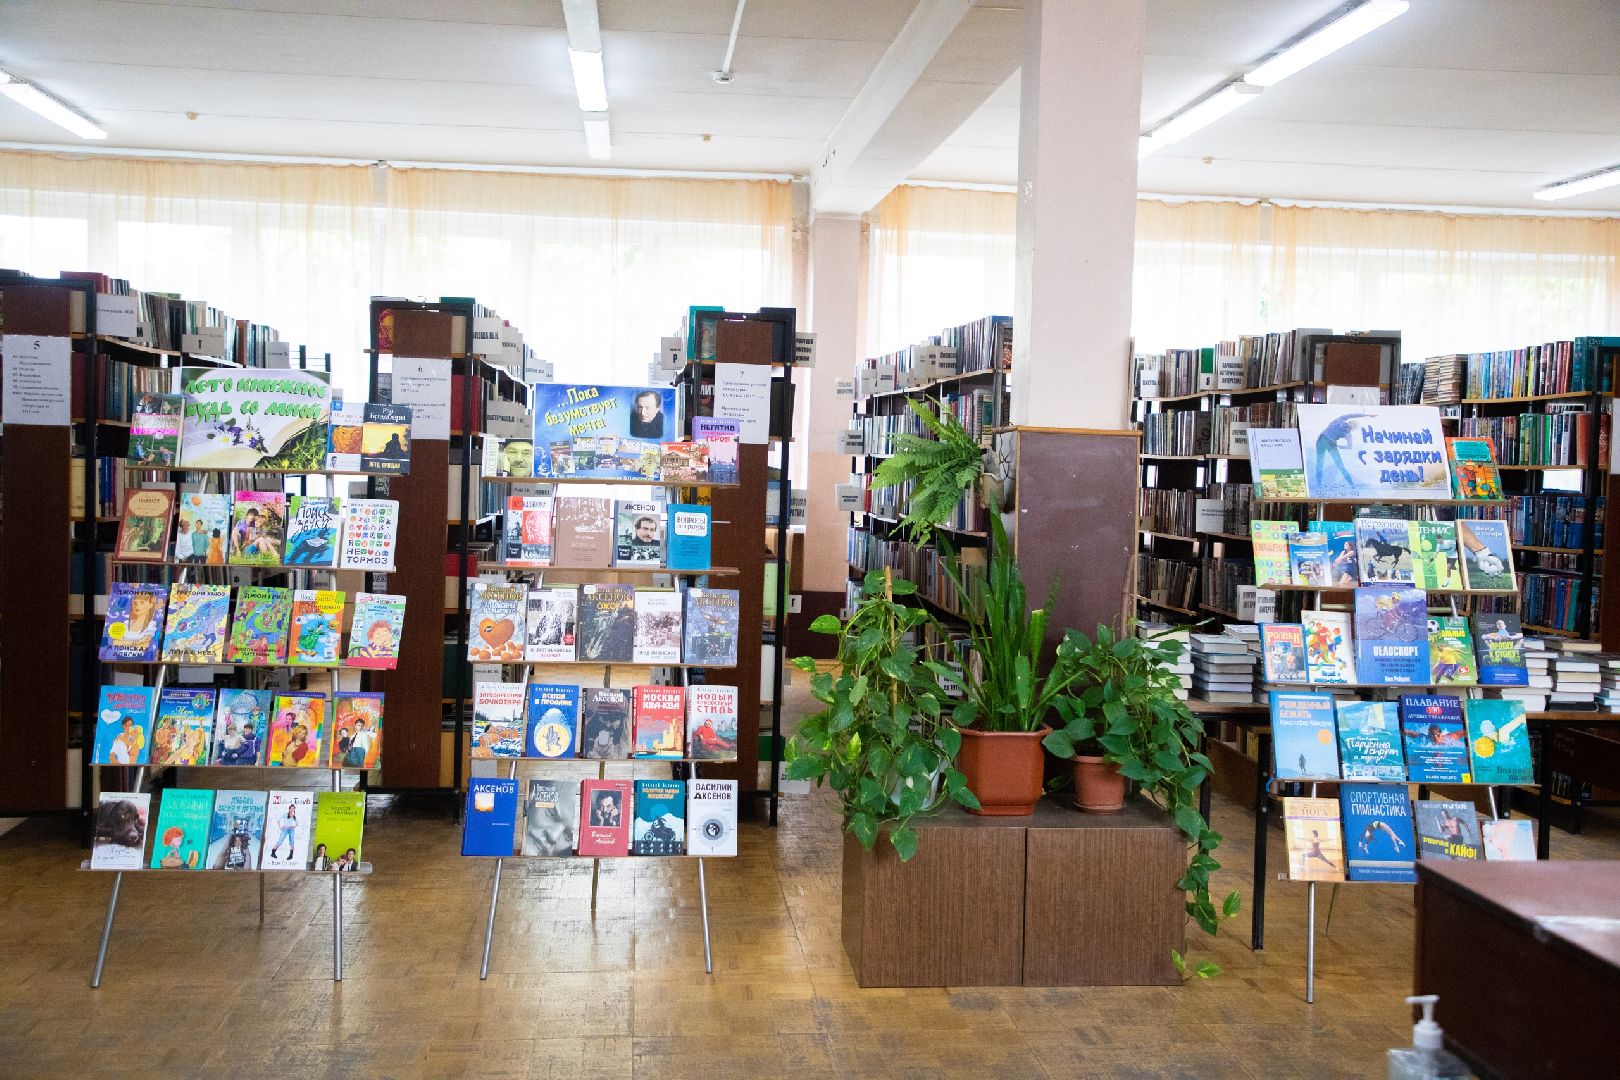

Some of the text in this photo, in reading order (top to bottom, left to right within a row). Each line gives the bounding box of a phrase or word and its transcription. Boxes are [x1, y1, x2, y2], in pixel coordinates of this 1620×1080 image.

[33, 341, 41, 350] 5
[185, 401, 233, 422] БУДЬ
[240, 400, 259, 415] СО
[544, 398, 618, 426] безумствует
[568, 417, 607, 436] мечта
[1361, 424, 1433, 445] Начинай
[1373, 450, 1442, 469] зарядки
[1380, 466, 1425, 483] день!
[624, 503, 656, 511] АКСЕНОВ
[1418, 526, 1452, 534] ТЕННИС
[346, 556, 388, 565] ТОРМОЗ
[1373, 646, 1418, 657] ВЕЛОСПОРТ
[643, 693, 681, 702] МОСКВА
[1405, 697, 1459, 708] ПЛАВАНИЕ
[643, 702, 680, 710] КВА-КВА
[473, 785, 514, 793] АКСЕНОВ
[694, 792, 732, 800] АКСЕНОВ
[1350, 791, 1405, 804] СПОРТИВНАЯ
[1302, 806, 1328, 817] ЙОГА
[1351, 803, 1407, 817] ГИМНАСТИКА
